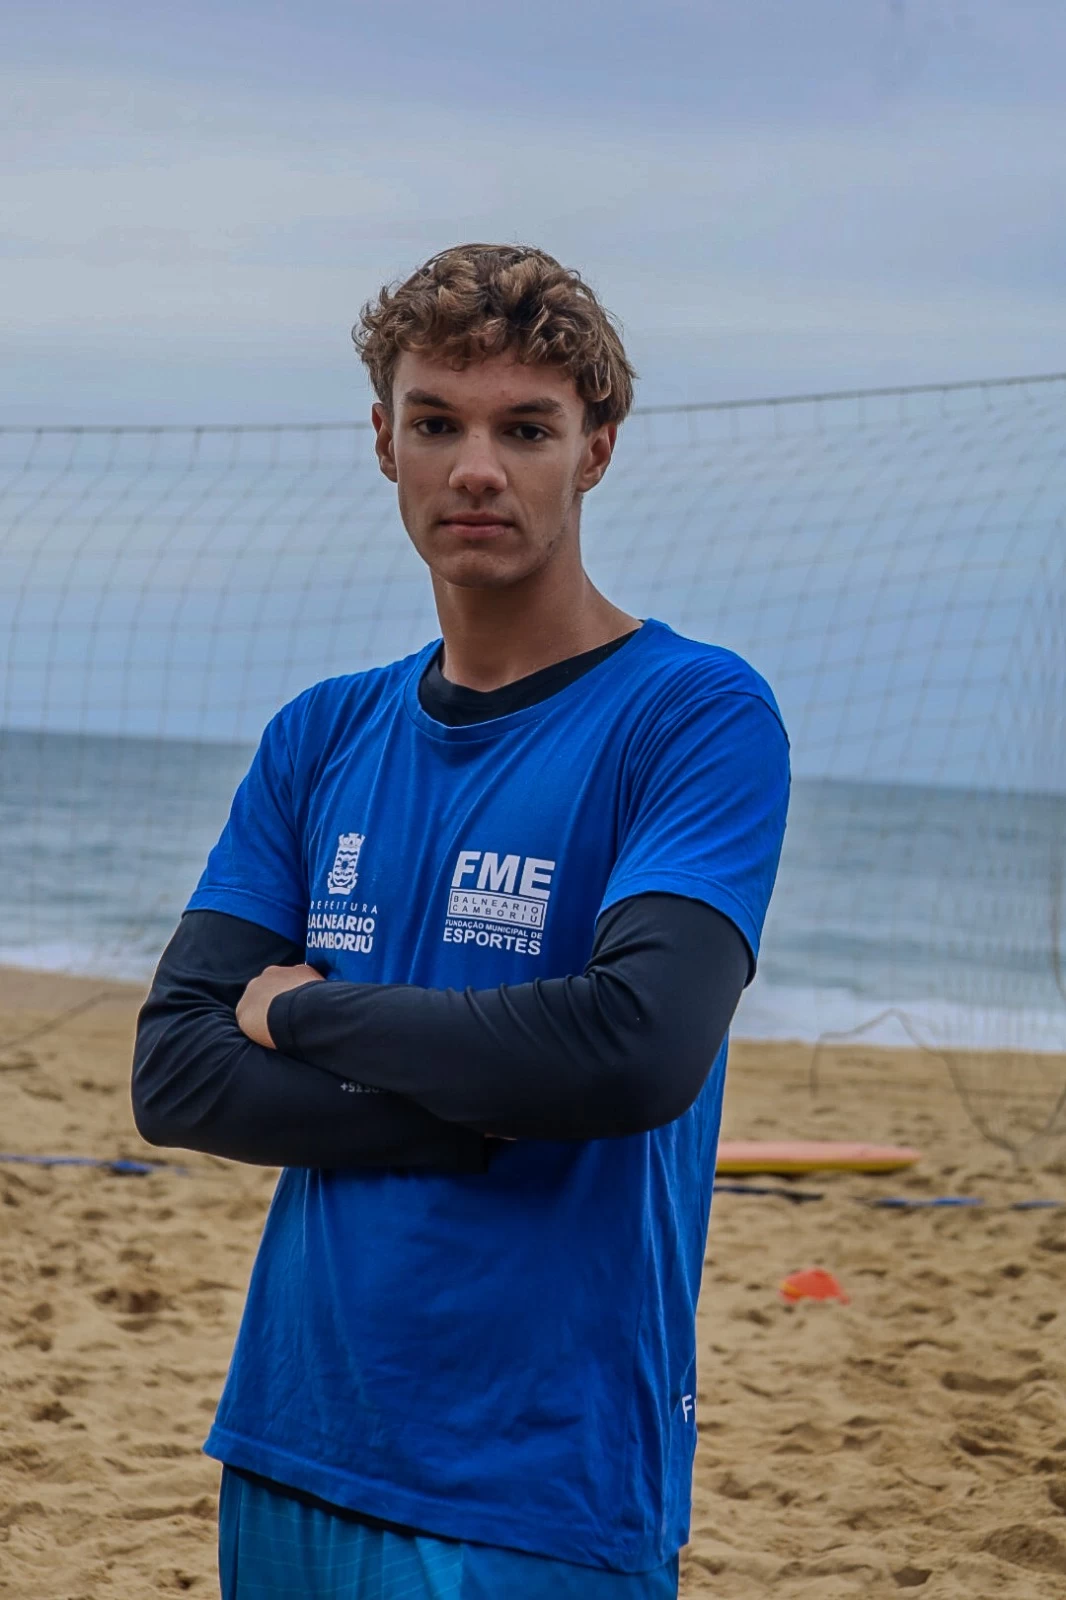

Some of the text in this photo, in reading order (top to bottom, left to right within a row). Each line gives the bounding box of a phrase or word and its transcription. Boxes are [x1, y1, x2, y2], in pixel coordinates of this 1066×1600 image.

[451, 850, 556, 900] FME
[310, 900, 378, 915] REFEITURA
[453, 895, 539, 914] BALNEARIO
[445, 919, 543, 940] FUNDAÇÃO MUNICIPAL DE
[443, 927, 541, 955] ESPORTES
